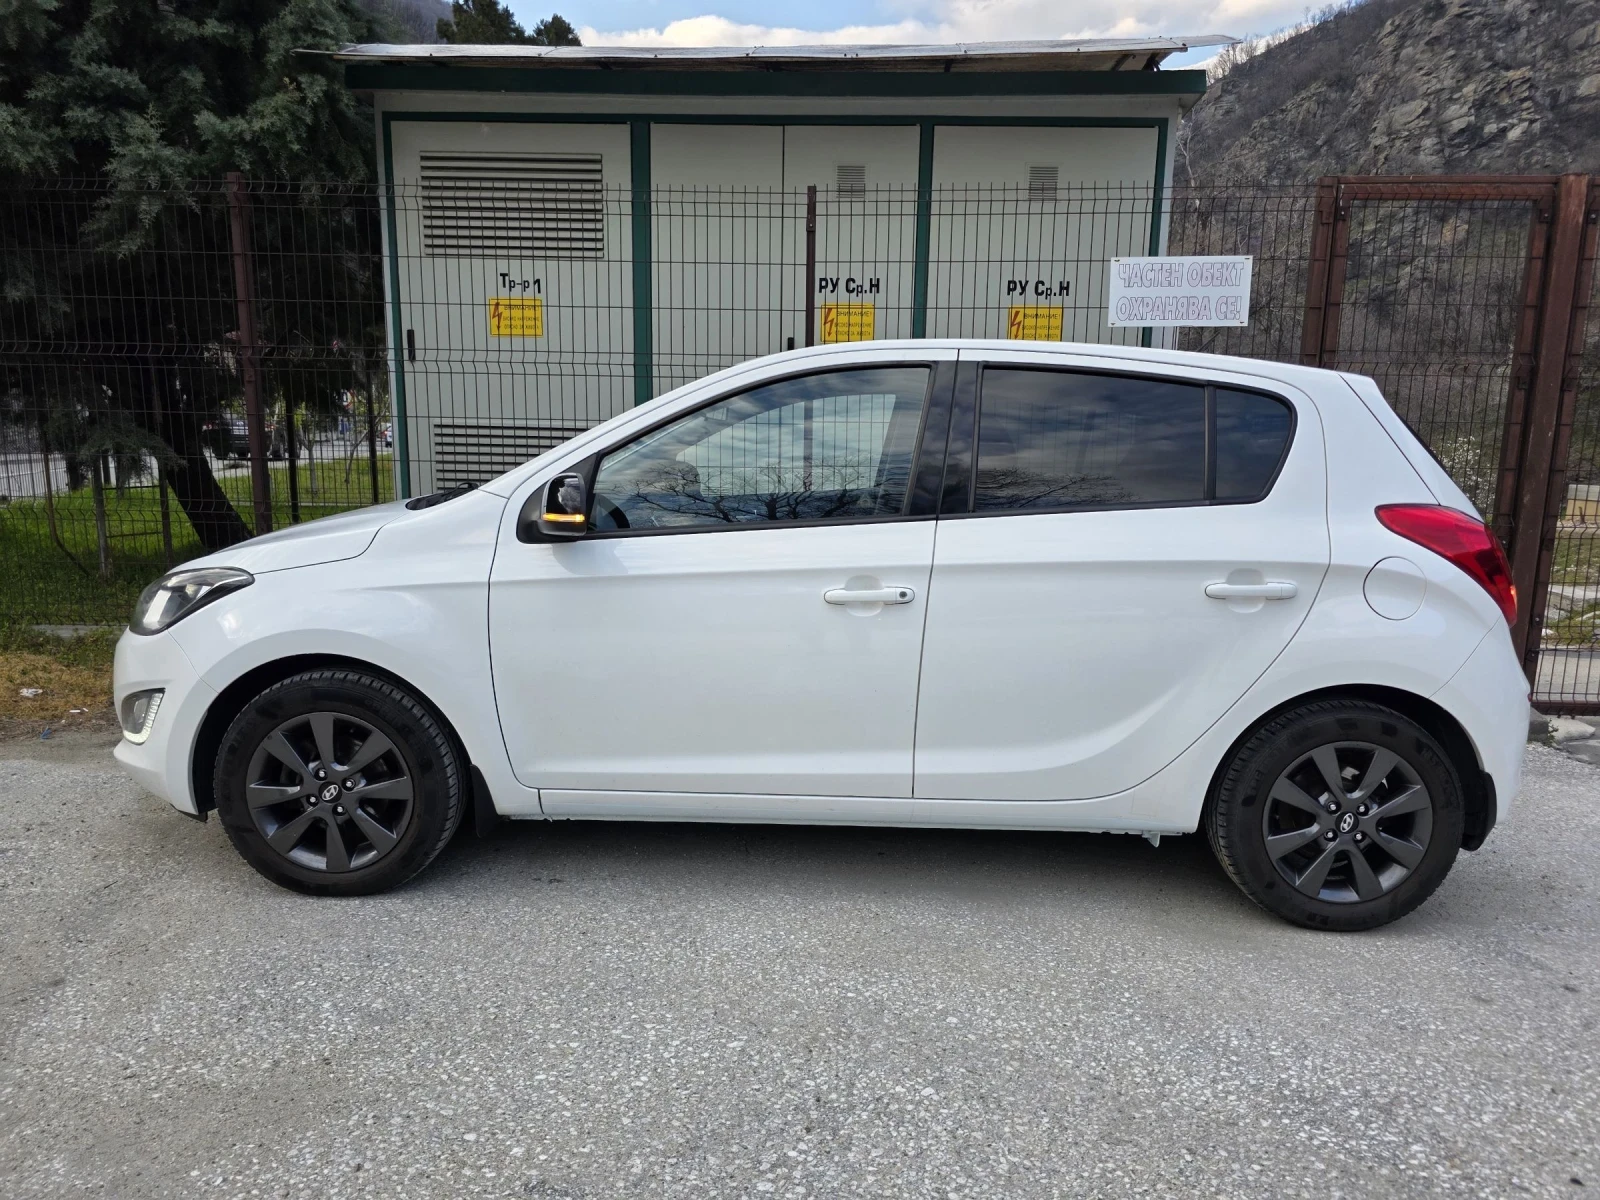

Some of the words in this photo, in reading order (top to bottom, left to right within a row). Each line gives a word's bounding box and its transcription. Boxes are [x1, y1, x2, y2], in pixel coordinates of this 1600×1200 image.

[818, 277, 840, 294] РУ
[1118, 262, 1184, 288] ЧАСТЕН
[1187, 262, 1245, 287] ОБЕКТ
[1007, 280, 1029, 296] РУ
[1116, 296, 1212, 322] ОХРАНЯВА
[1215, 295, 1243, 321] СЕ!
